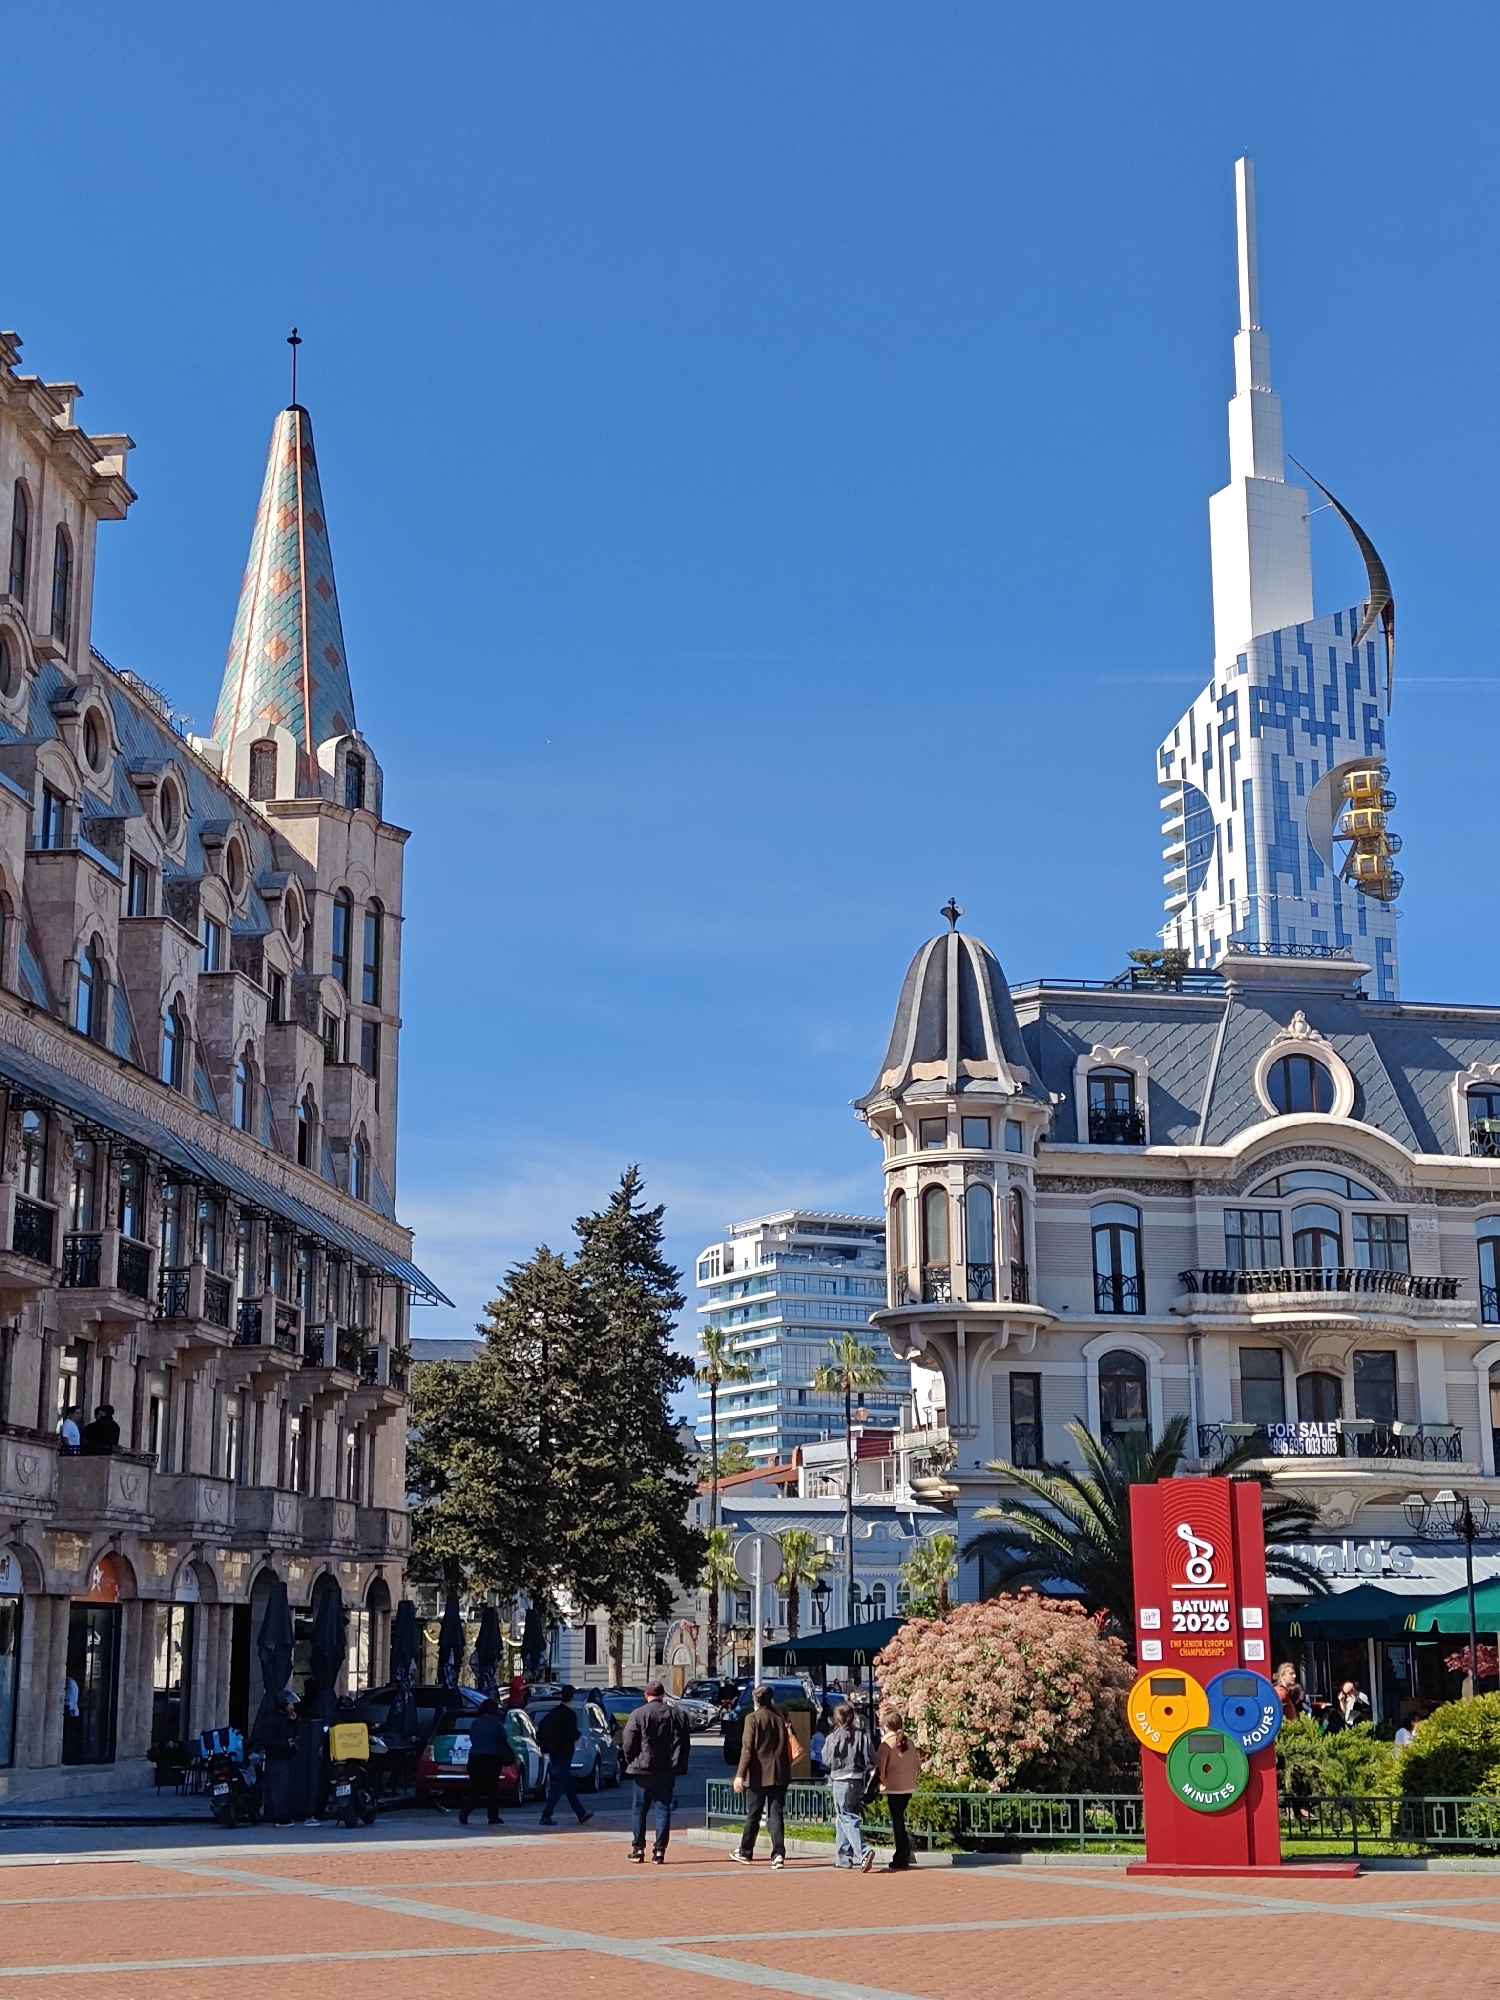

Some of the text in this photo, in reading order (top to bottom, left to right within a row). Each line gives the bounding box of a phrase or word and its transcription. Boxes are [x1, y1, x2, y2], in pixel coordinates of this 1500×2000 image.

[1267, 1422, 1337, 1438] FOR SALE
[1172, 1600, 1229, 1613] BATUMI
[1171, 1613, 1230, 1632] 2026
[1135, 1711, 1161, 1743] DAYS
[1242, 1706, 1274, 1747] HOURS
[1181, 1783, 1235, 1804] MINUTES
